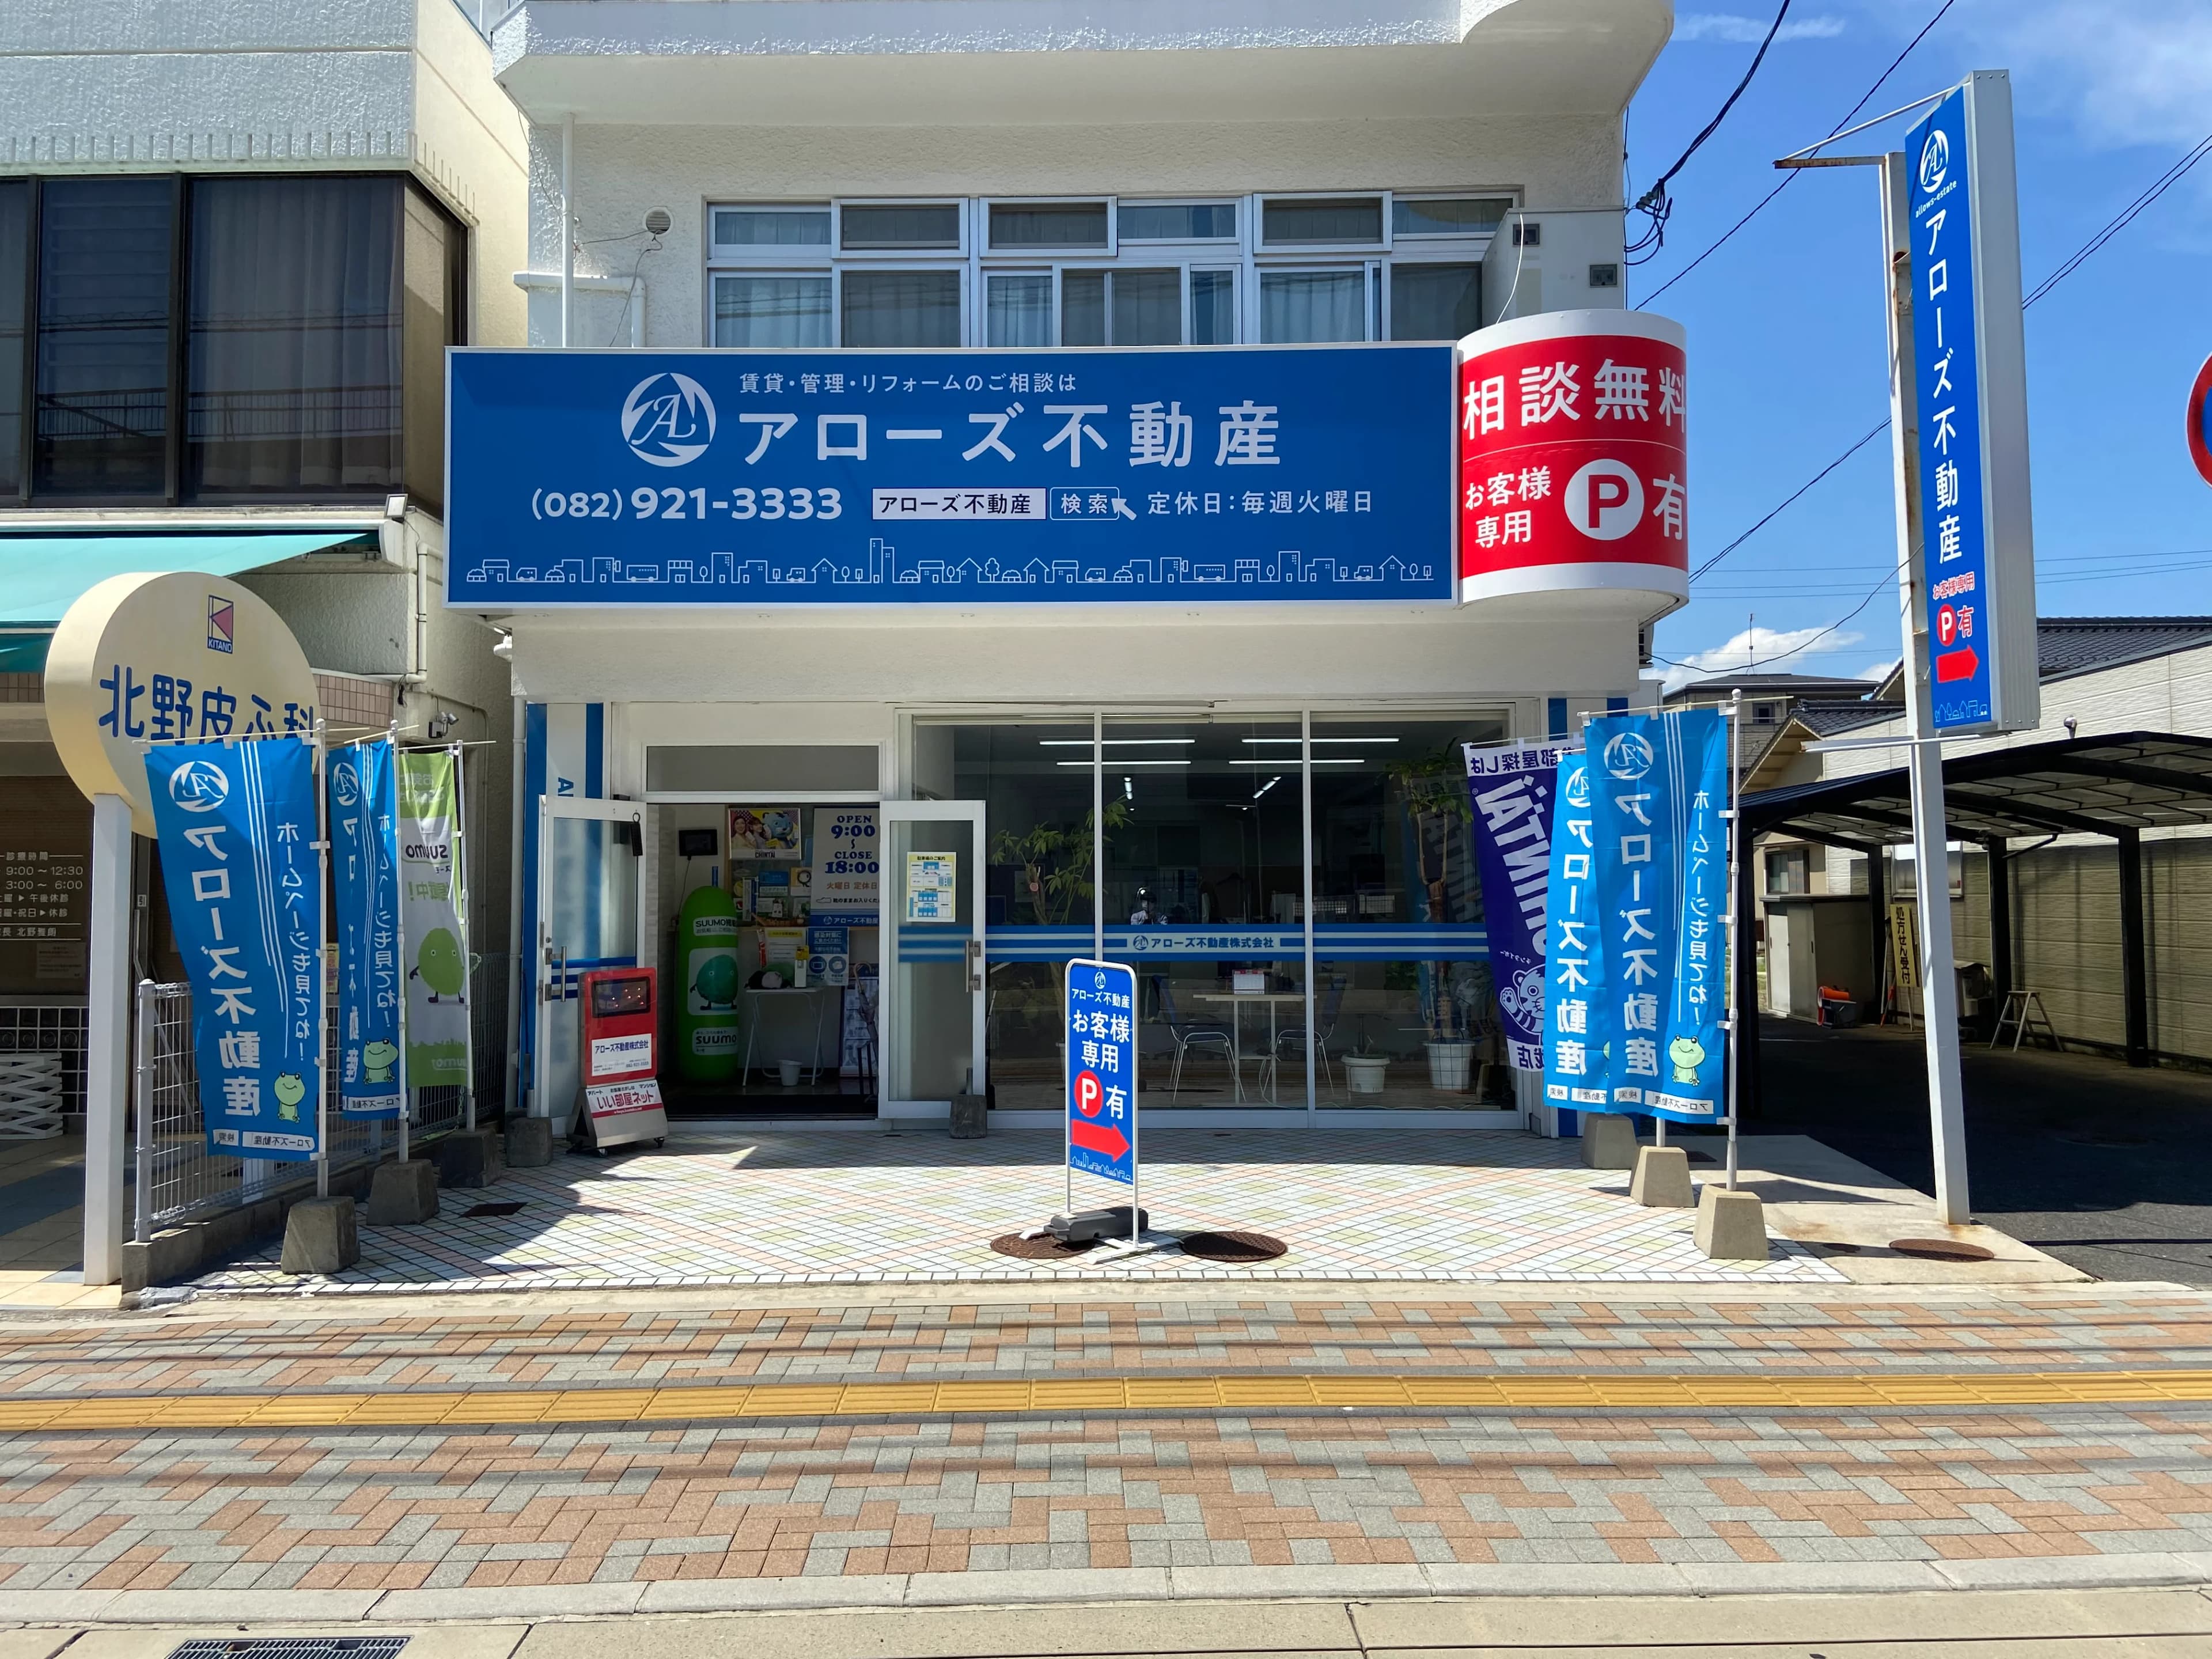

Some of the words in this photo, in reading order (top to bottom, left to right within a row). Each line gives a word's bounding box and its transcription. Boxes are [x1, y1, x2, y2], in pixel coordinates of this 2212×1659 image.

[1915, 180, 1957, 218] allows-estate
[739, 372, 1077, 394] 賃貸・管理・リフォームのご相談は
[1925, 209, 1962, 564] アローズ不動産
[1463, 358, 1687, 440] 相談無料
[738, 400, 1281, 468] アローズ不動産
[1465, 465, 1552, 510] お客様
[1588, 474, 1630, 529] P
[879, 493, 1032, 515] アローズ不動産
[1060, 493, 1109, 515] 検索
[1652, 473, 1686, 540] 有
[1475, 509, 1532, 548] 専用
[1932, 571, 1975, 600] お客様専用
[1941, 611, 1953, 641] P
[1956, 604, 1975, 639] 有
[208, 638, 233, 654] KITANO
[830, 825, 876, 839] 9:00
[836, 815, 873, 823] OPEN
[6, 851, 49, 861] 診療時間
[824, 861, 880, 874] 18:00
[834, 851, 872, 859] CLOSE
[29, 893, 69, 903] 午後休診
[48, 908, 68, 918] 休診
[1151, 937, 1274, 949] アローズ不動産株式会社
[1895, 906, 1911, 985] 処方せん受付
[1071, 988, 1131, 1009] アローズ不動産
[1072, 1009, 1130, 1044] お客様
[594, 1039, 649, 1054] アローズ不動産株式会社
[1081, 1040, 1119, 1074] 専用
[597, 1089, 654, 1109] いい部屋ネット
[1081, 1077, 1097, 1110] P
[1105, 1084, 1128, 1120] 有
